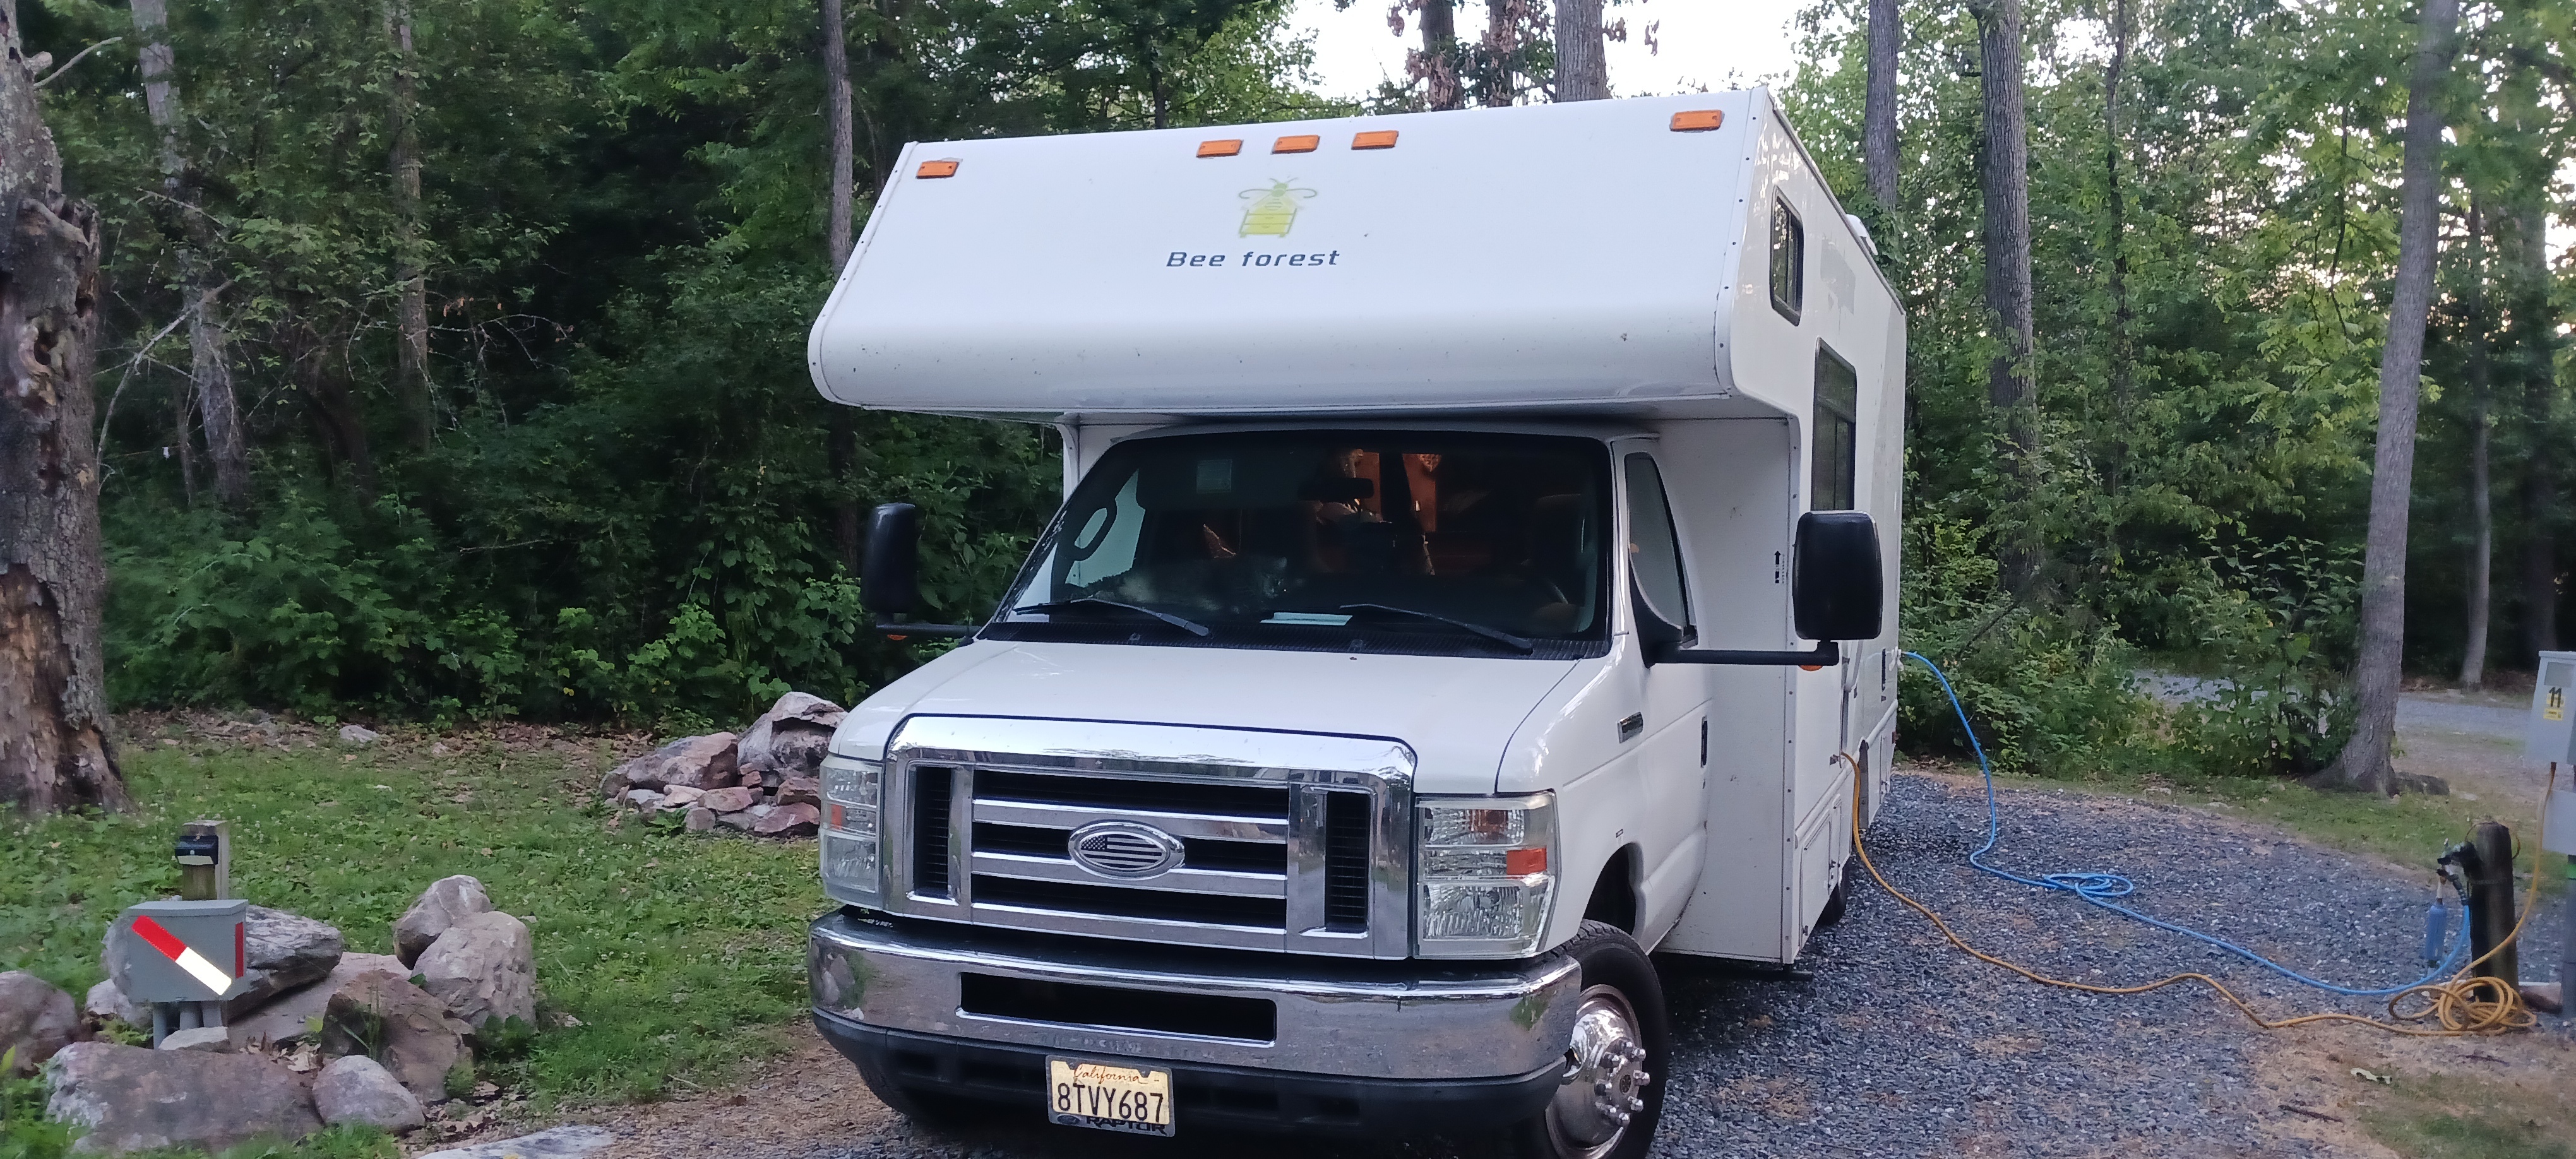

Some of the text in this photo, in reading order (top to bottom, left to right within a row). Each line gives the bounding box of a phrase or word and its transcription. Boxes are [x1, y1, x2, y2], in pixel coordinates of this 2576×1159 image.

[1166, 250, 1340, 267] Bee forest
[2549, 686, 2562, 708] 11
[1073, 1064, 1148, 1085] California
[1058, 1083, 1164, 1122] 8TVY687
[1086, 1115, 1168, 1136] RAPTOR
